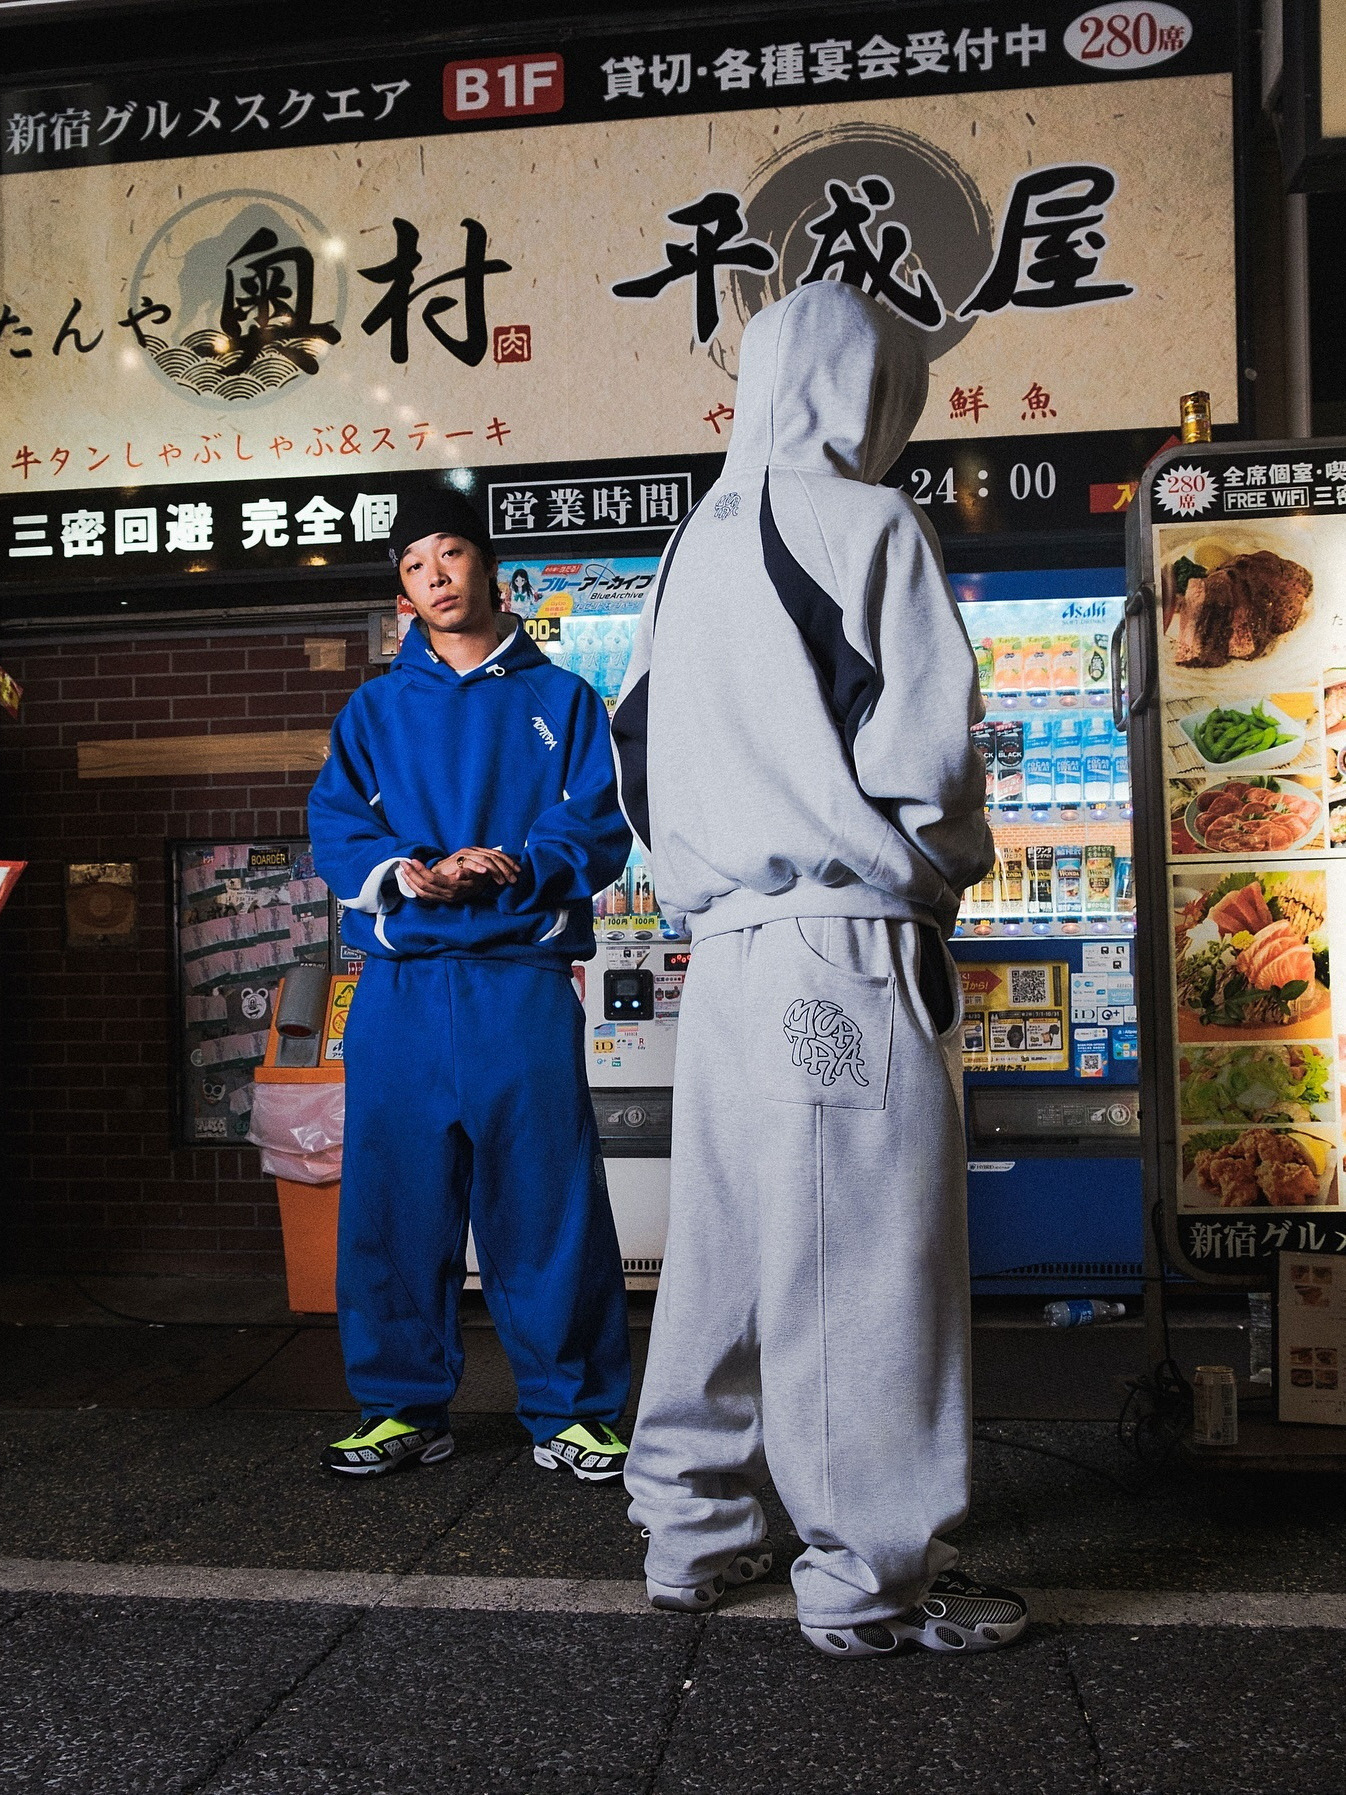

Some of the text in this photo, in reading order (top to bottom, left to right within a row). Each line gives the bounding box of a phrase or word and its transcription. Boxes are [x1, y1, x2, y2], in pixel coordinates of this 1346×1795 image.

[601, 23, 1047, 101] 貸切・各種宴会受付中
[455, 61, 558, 111] B1F
[5, 79, 412, 156] 新宿グルメスクエア
[613, 164, 1134, 345] 平成屋
[0, 217, 512, 376] たんや 奥村
[949, 382, 1057, 424] 鮮魚
[11, 417, 512, 480] 牛タンしゃぶしゃぶ&ステーキ
[1167, 474, 1206, 494] 280
[499, 482, 679, 531] 営業時間
[1178, 493, 1196, 509] 席
[1227, 491, 1268, 509] FREE
[1271, 489, 1305, 507] WiFi
[9, 492, 398, 558] 三密回避 完全個
[538, 574, 657, 592] ブルーアーカイブ
[1062, 601, 1107, 619] Asahi
[251, 853, 286, 865] BOARDER
[607, 918, 628, 926] 100円
[635, 917, 655, 925] 100円
[1074, 1009, 1096, 1019] iD
[595, 1041, 614, 1051] iD
